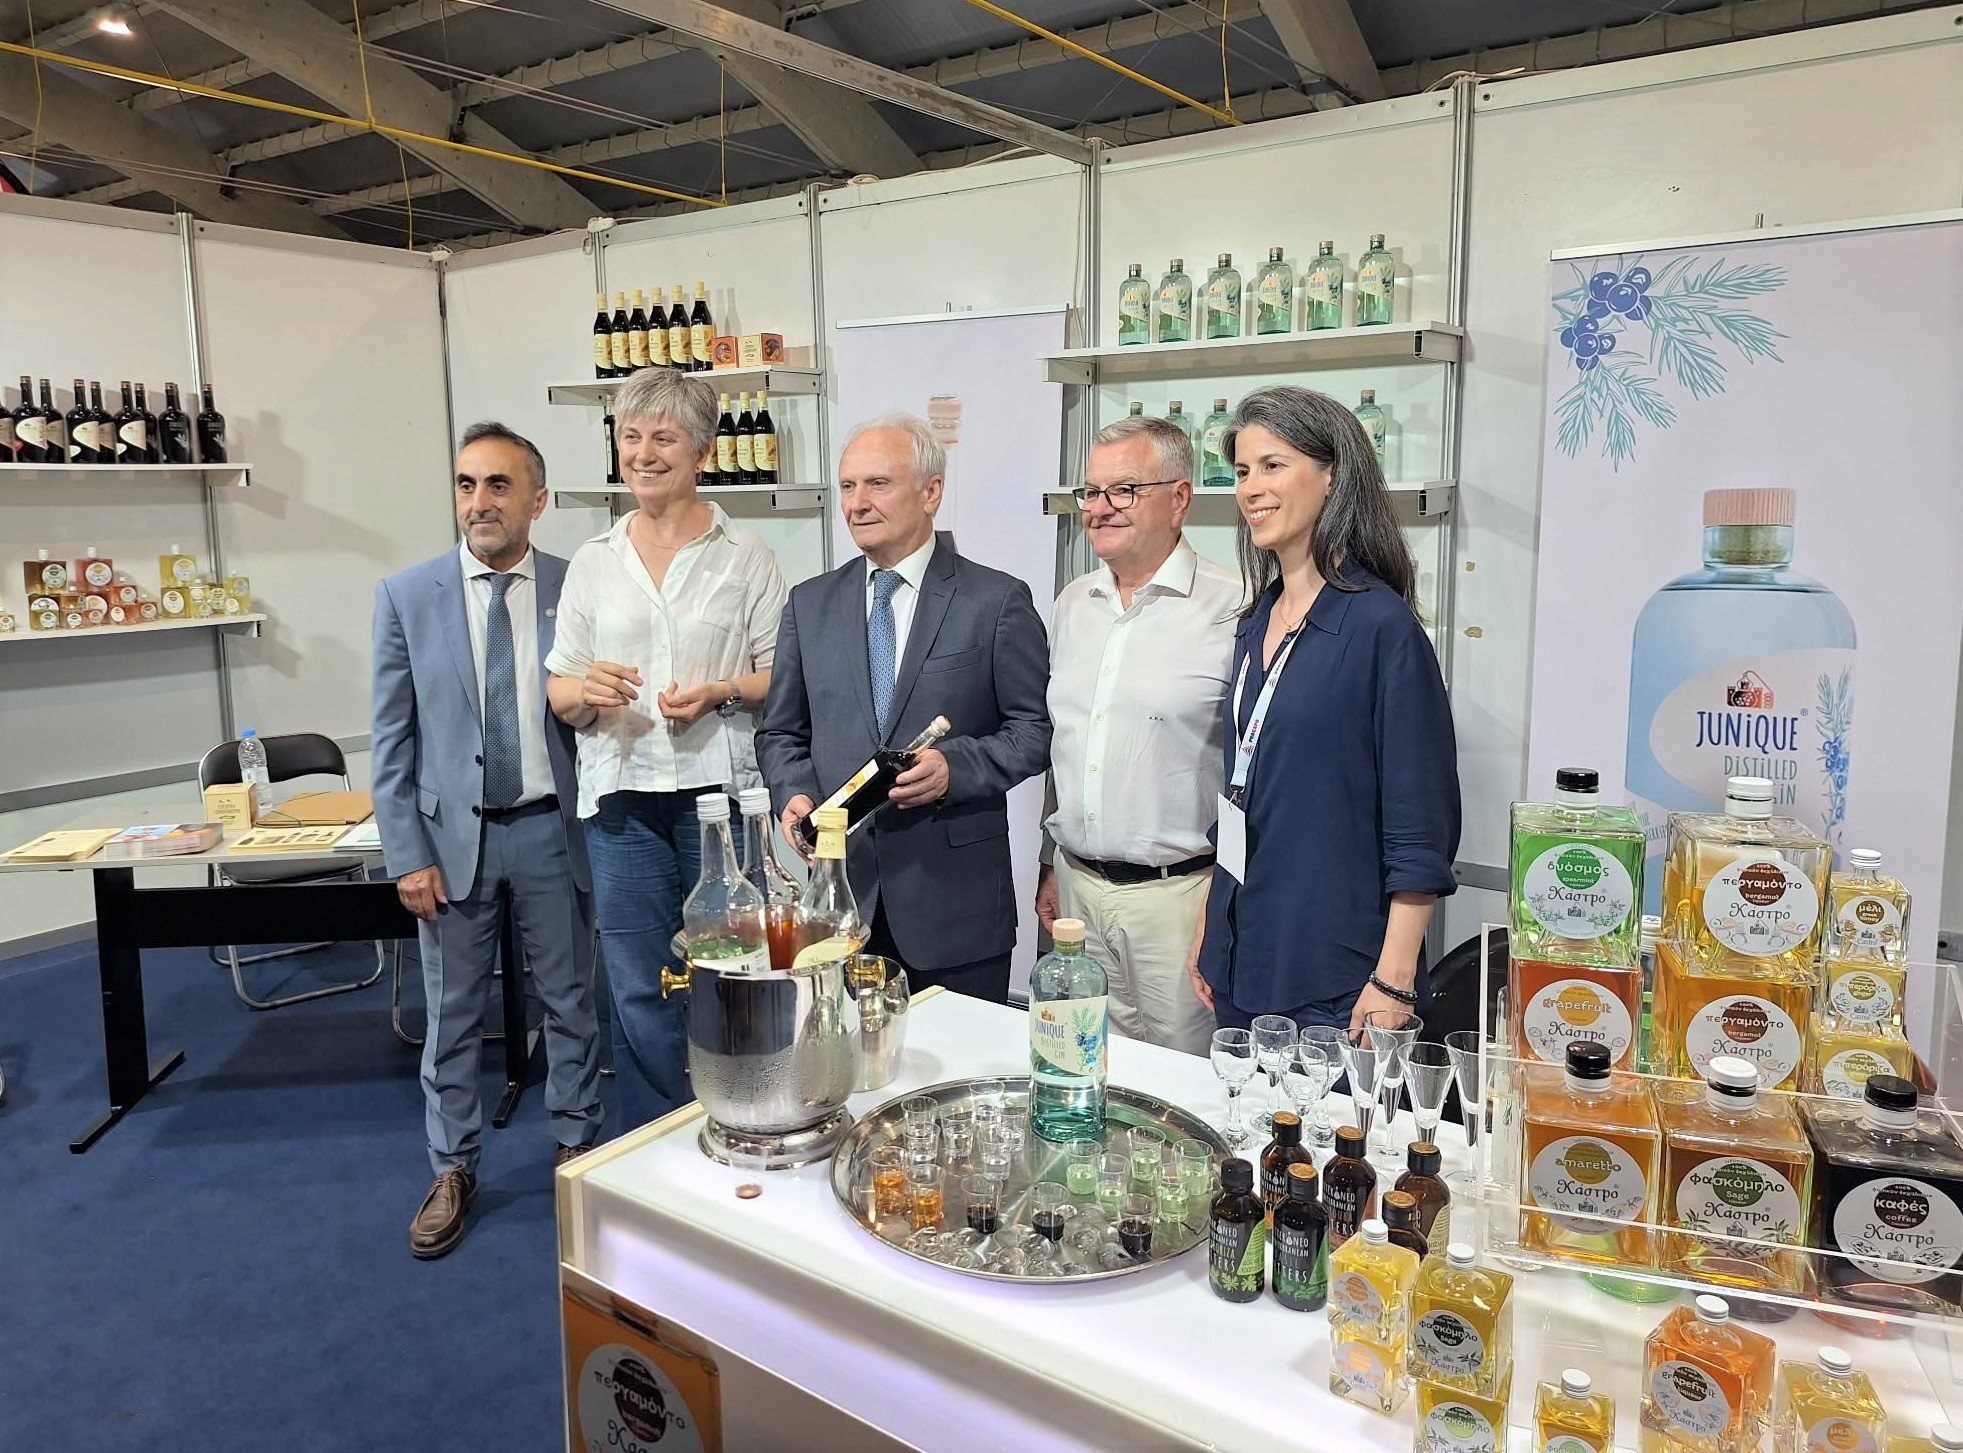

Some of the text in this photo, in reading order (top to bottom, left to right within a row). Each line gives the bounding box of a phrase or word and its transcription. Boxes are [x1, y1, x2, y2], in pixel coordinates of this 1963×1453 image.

[1547, 861, 1610, 877] δυόσμος
[1721, 878, 1803, 890] περγαμόντο
[1542, 997, 1612, 1014] grapefruit
[1705, 1015, 1784, 1029] περγαμόντο
[1555, 1157, 1622, 1172] amaretto
[1689, 1172, 1785, 1193] φασκόμηλο
[1725, 1190, 1750, 1201] Sage
[1875, 1199, 1928, 1216] καφές
[1885, 1214, 1918, 1223] coffee
[1418, 1320, 1478, 1342] φασκόμηλο
[1661, 1371, 1717, 1399] grapefruit
